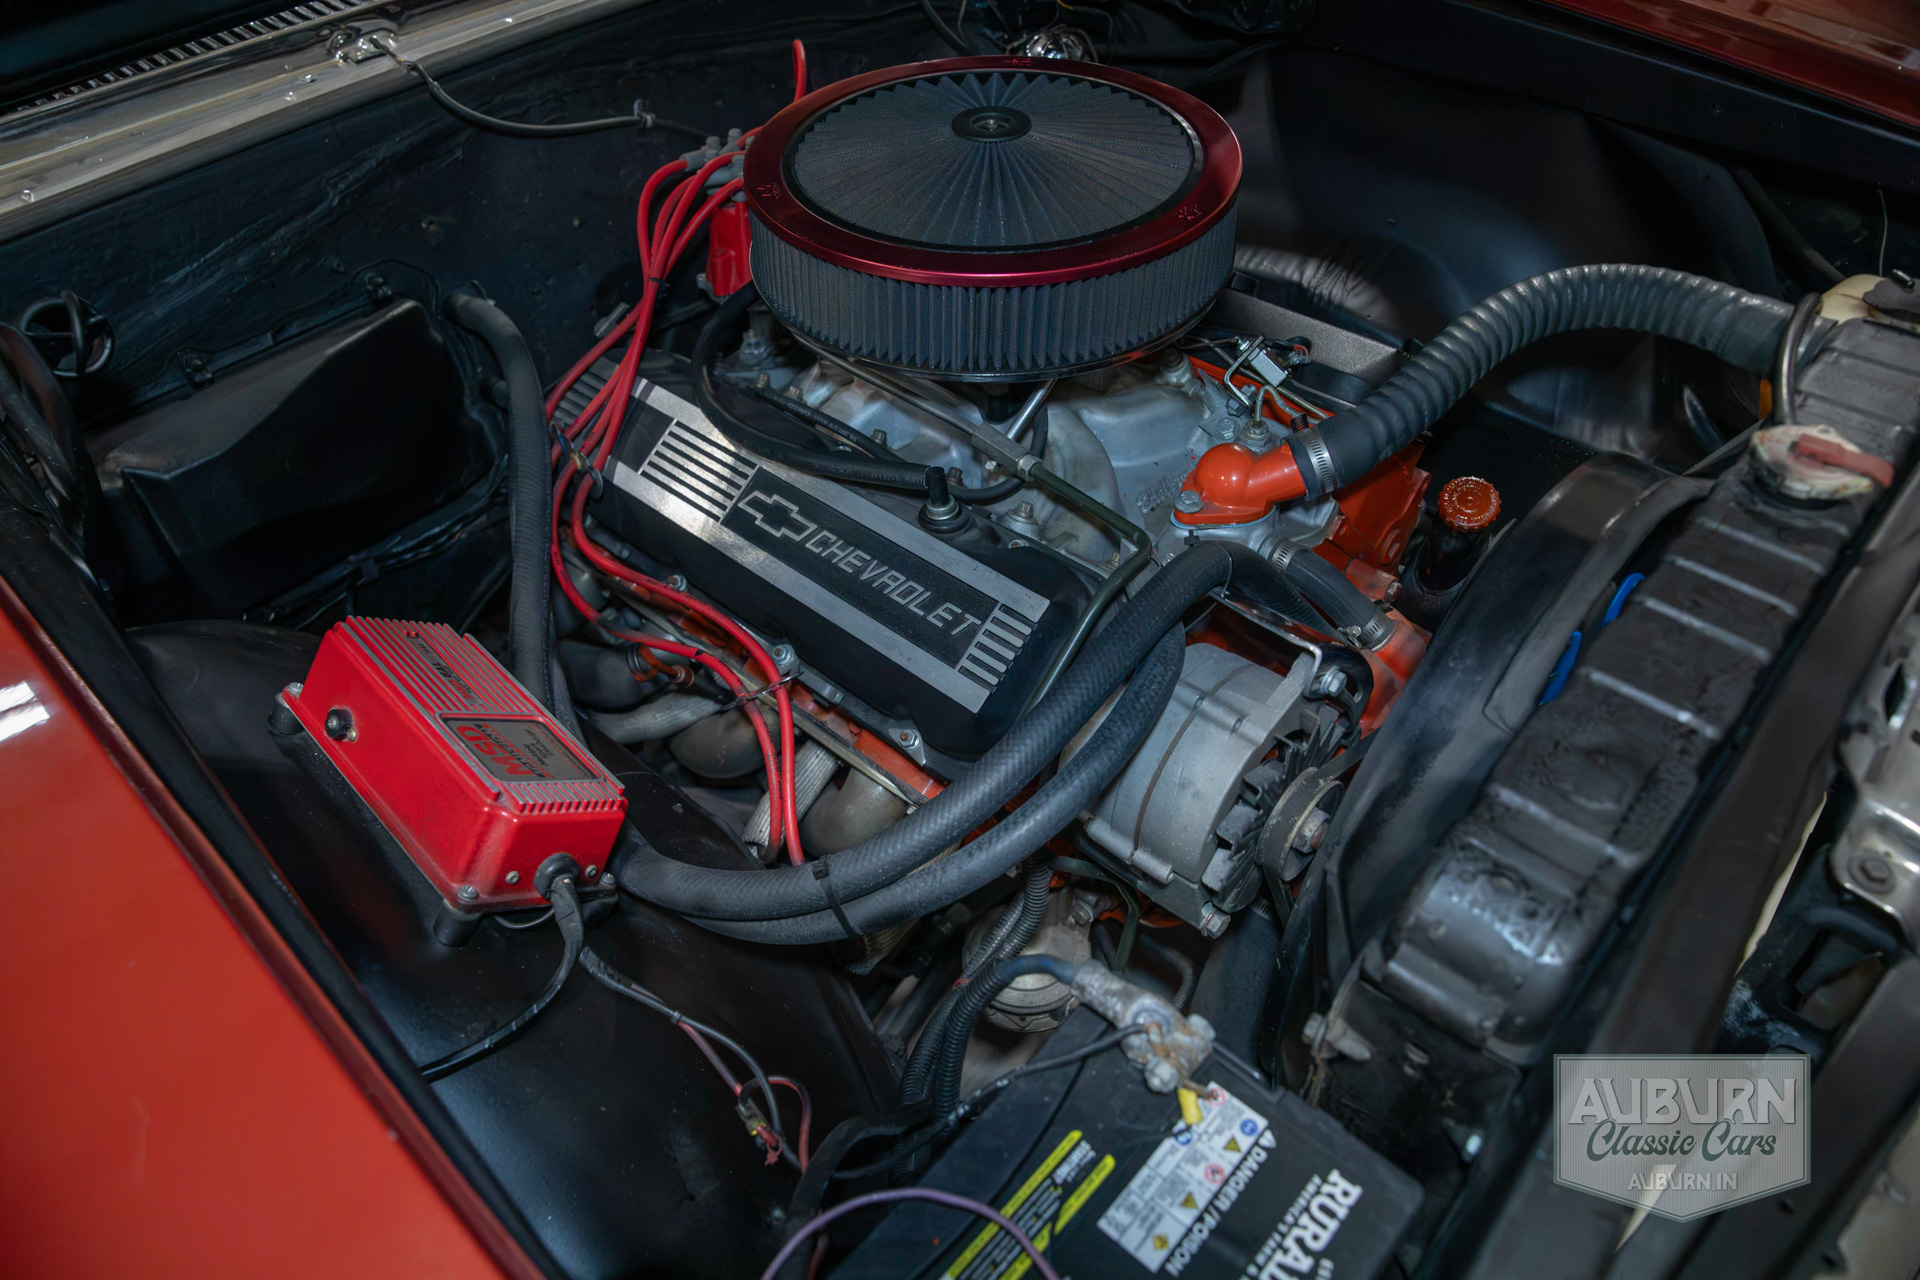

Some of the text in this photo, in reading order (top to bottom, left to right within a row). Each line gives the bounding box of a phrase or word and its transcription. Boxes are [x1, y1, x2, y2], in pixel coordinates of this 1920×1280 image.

[805, 530, 982, 636] CHEVROLET
[448, 679, 475, 700] MSD
[456, 725, 535, 776] MSD
[476, 724, 550, 777] IGNITION
